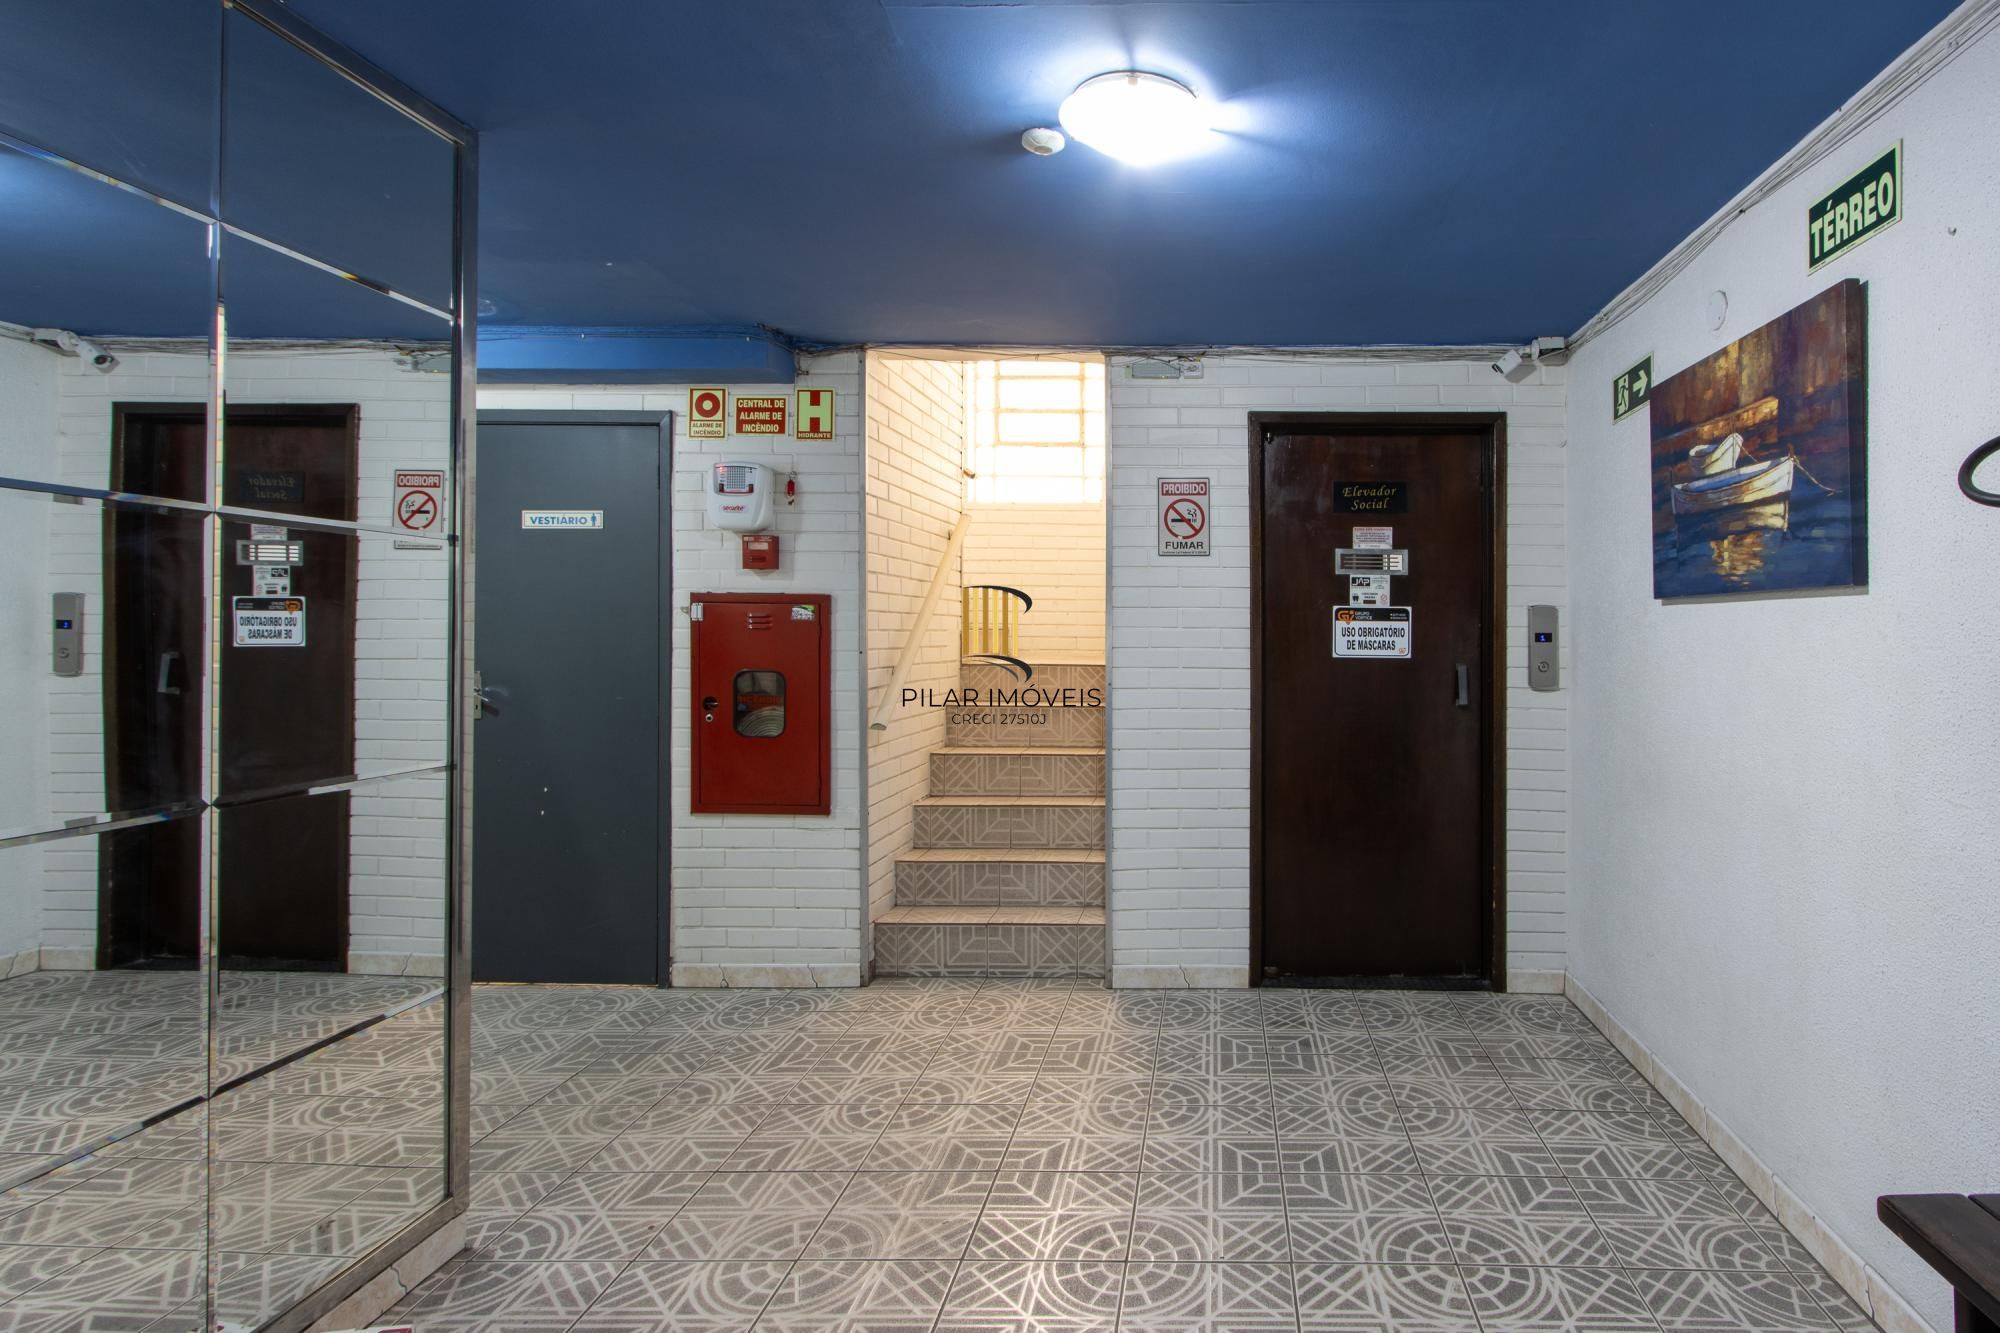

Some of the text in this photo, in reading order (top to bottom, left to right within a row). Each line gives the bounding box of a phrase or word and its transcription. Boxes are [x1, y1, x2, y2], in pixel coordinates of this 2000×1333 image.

[1811, 171, 1894, 259] TÉRREO
[737, 399, 785, 408] CENTRAL DE
[739, 411, 783, 420] ALARME DE
[798, 391, 832, 432] H
[742, 422, 779, 432] INCÊNDIO
[1162, 483, 1206, 494] PROIBIDO
[1342, 484, 1397, 497] Elevador
[1351, 497, 1390, 511] Social
[1165, 541, 1204, 549] FUMAR
[1341, 624, 1405, 638] USO OBRIGATÓRIO
[1346, 637, 1396, 651] DE MÁSCARAS
